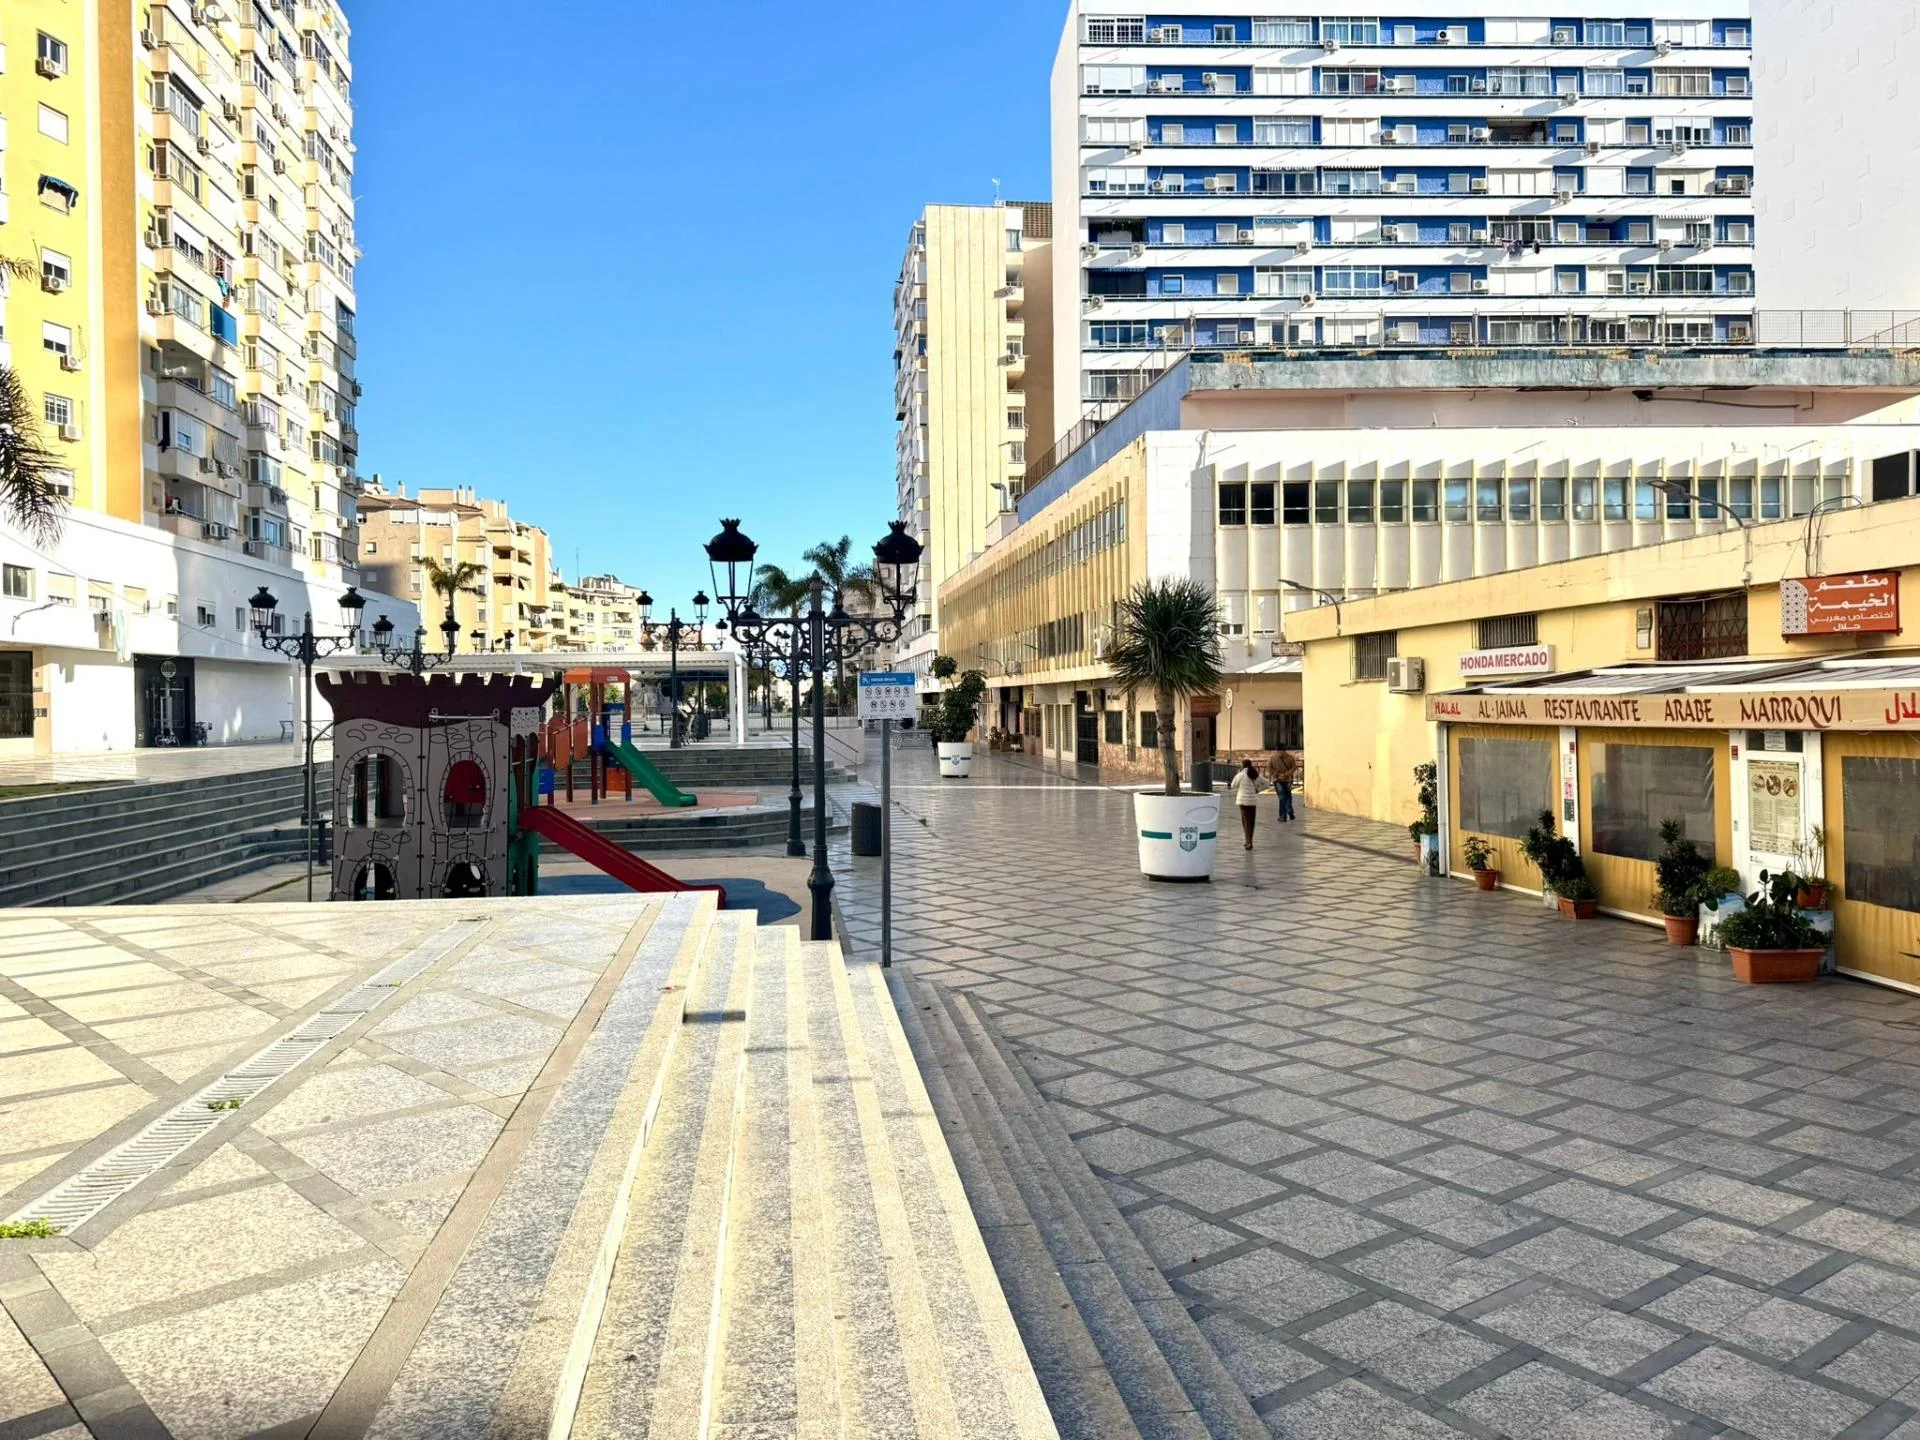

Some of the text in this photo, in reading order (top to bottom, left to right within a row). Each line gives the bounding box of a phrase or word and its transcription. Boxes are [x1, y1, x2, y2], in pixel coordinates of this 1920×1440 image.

[1815, 574, 1889, 593] مطعم
[1808, 592, 1895, 613] الخيمة
[1809, 611, 1893, 625] اختصاص مغربي
[1833, 623, 1861, 632] حلال
[1434, 702, 1461, 715] HALAL
[1544, 699, 1641, 722] RESTAURANTE
[1664, 699, 1715, 723] ARABE
[1740, 695, 1842, 728] MARROQUI
